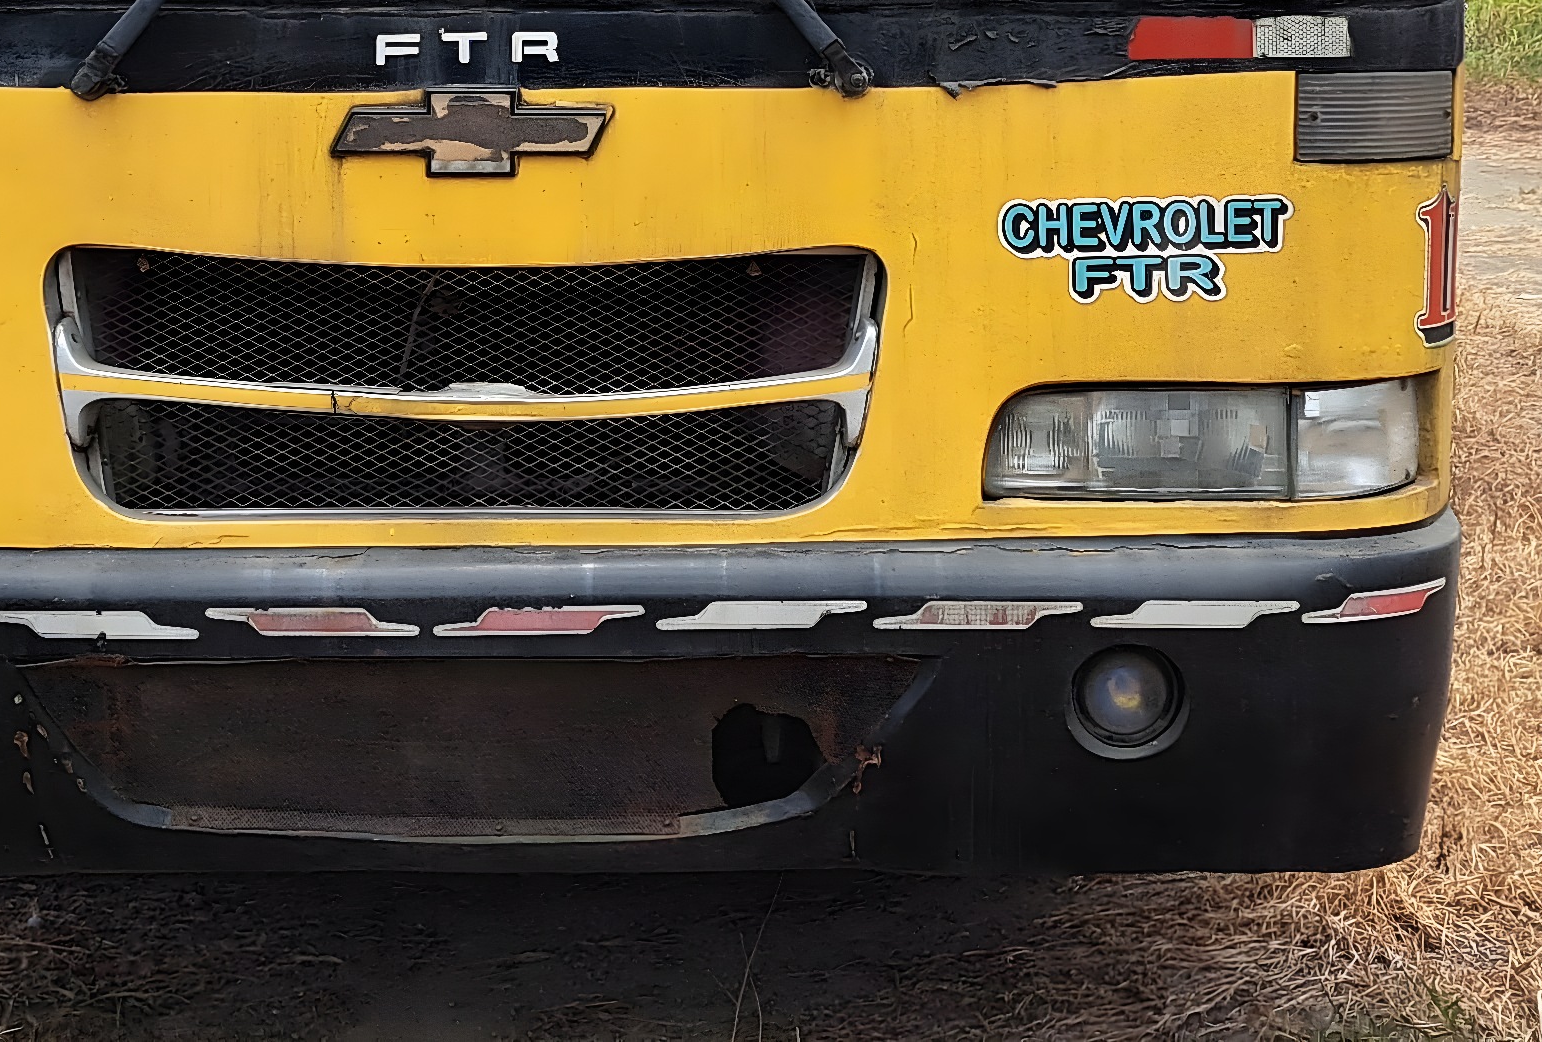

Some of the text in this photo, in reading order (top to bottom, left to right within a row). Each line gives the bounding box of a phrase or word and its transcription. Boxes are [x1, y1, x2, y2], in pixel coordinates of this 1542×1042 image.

[376, 27, 559, 65] FTR
[999, 194, 1294, 257] CHEVROLET
[1068, 254, 1227, 303] FTR
